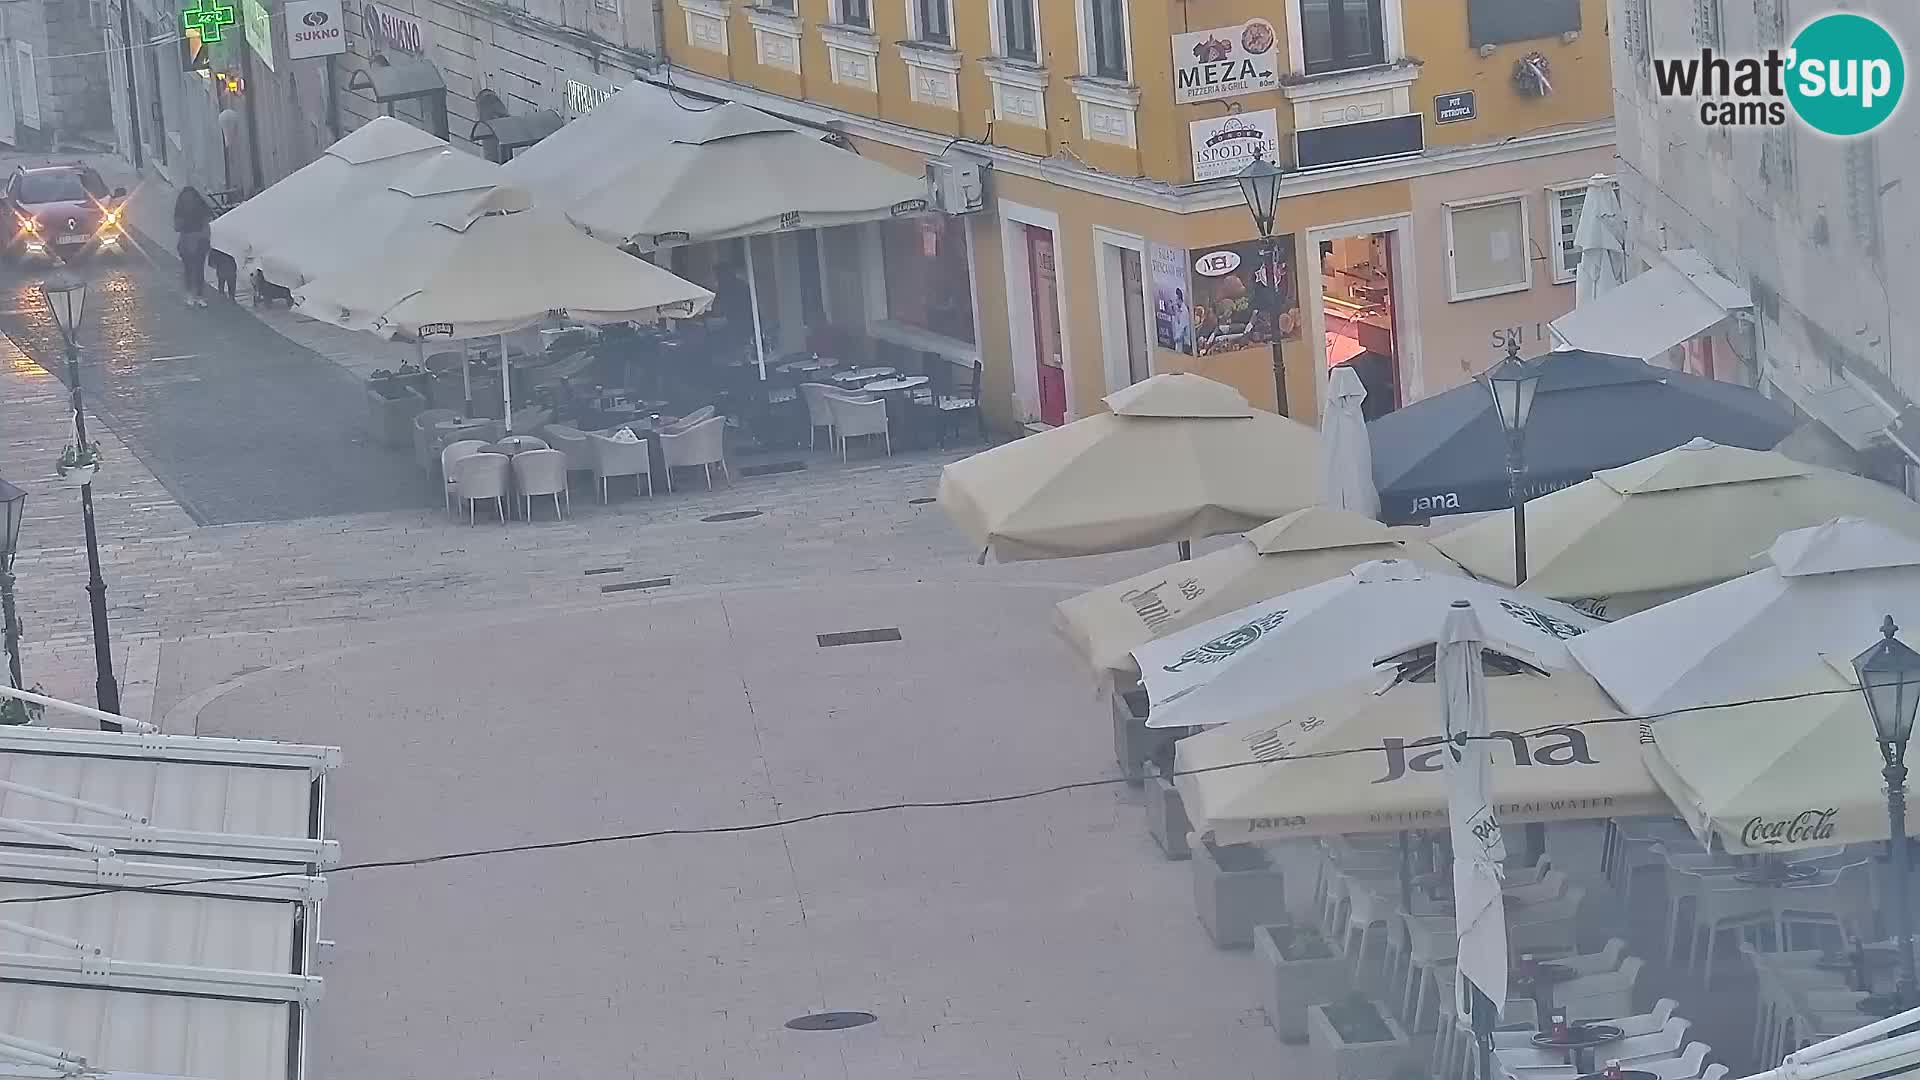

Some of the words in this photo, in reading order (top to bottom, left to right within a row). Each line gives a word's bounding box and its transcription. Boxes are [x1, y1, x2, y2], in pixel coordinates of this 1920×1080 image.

[295, 28, 339, 42] SUKNO
[381, 12, 421, 52] SUKNO
[1178, 59, 1257, 88] MEZA
[1187, 85, 1220, 97] PIZZERIA
[1220, 83, 1228, 92] &
[1228, 80, 1249, 92] GRILL
[1440, 106, 1471, 119] PETROVCA
[1449, 97, 1461, 107] PUT
[1196, 145, 1242, 163] ISPOD
[1247, 138, 1276, 156] URE
[1370, 808, 1449, 822] NATURA
[1550, 796, 1615, 811] WATER
